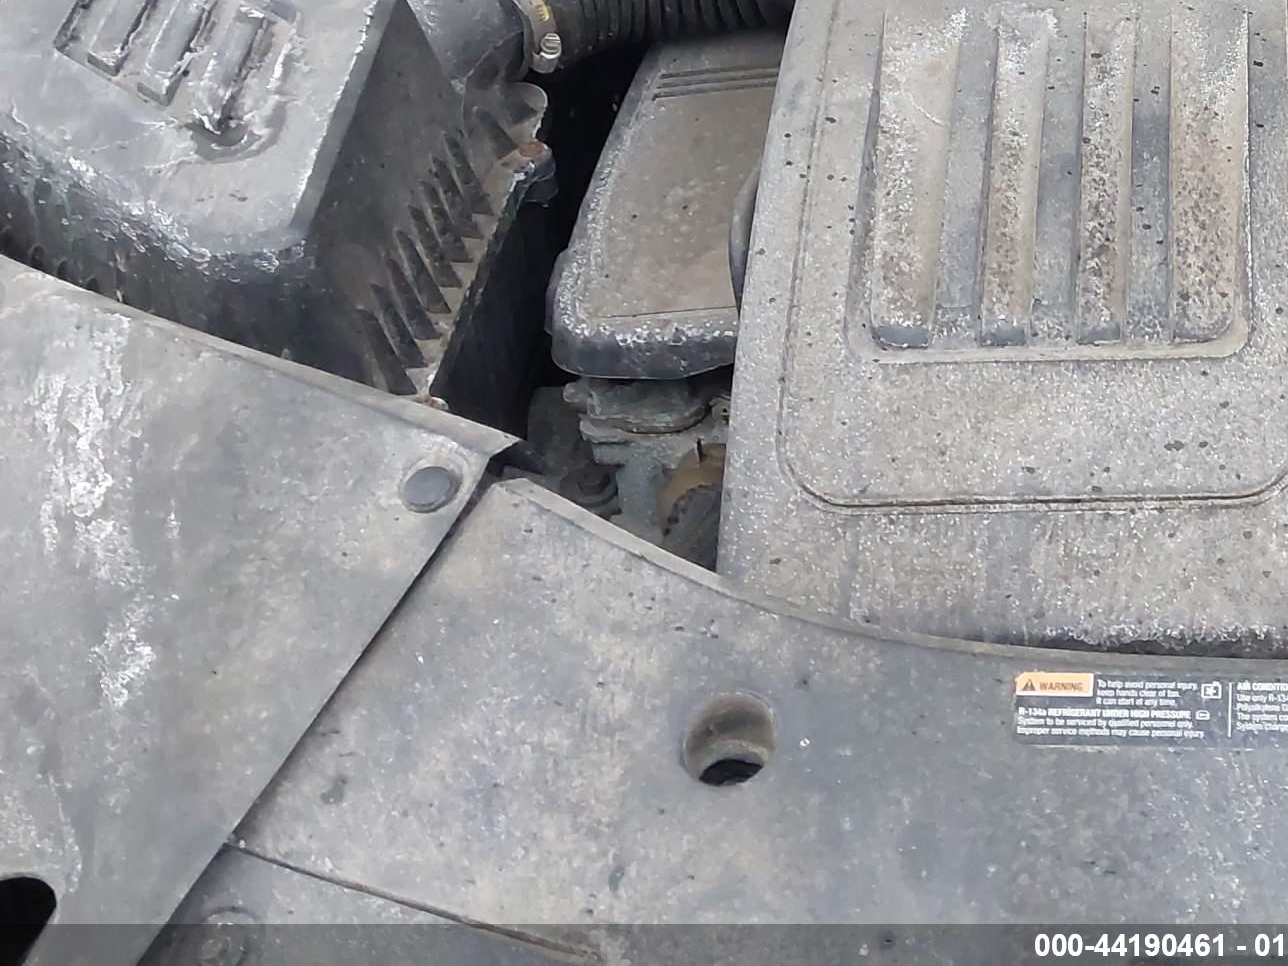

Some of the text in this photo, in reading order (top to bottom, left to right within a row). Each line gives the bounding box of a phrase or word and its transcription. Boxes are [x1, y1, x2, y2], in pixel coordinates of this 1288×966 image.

[1040, 682, 1083, 691] WARNING
[1237, 680, 1251, 691] AIR
[1236, 694, 1250, 702] Use
[1018, 706, 1191, 719] R-134a REFRIGERANT UNDER HIGH PRESSURE
